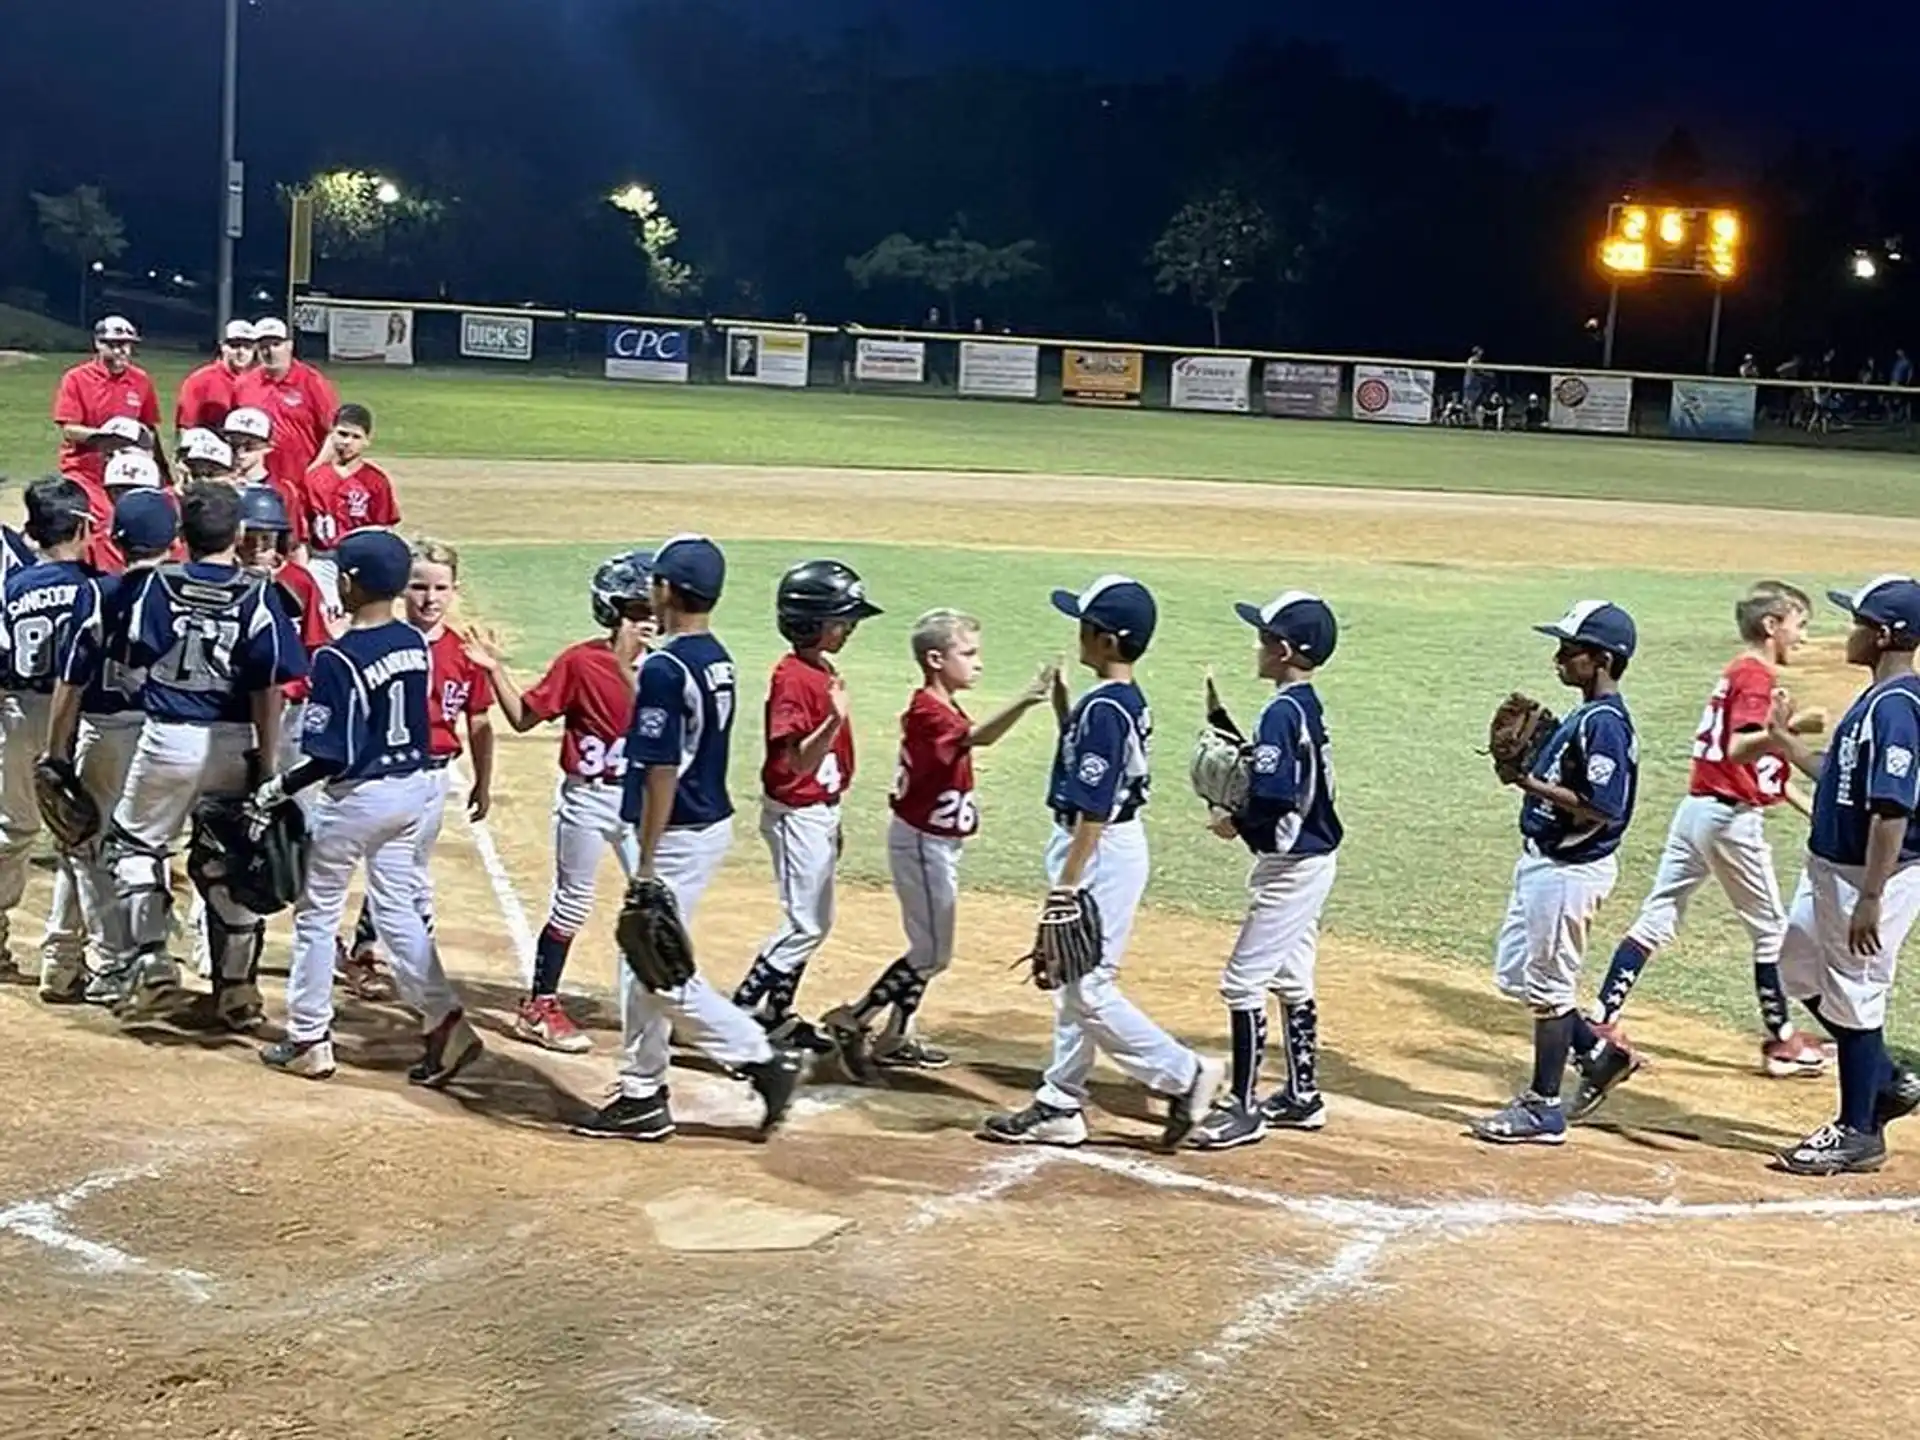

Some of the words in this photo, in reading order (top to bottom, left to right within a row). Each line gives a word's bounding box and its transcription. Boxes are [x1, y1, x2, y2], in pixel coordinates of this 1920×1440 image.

[614, 328, 680, 359] CPC
[386, 680, 410, 746] 1
[577, 734, 629, 777] 34
[815, 751, 842, 794] 4
[927, 788, 978, 833] 26
